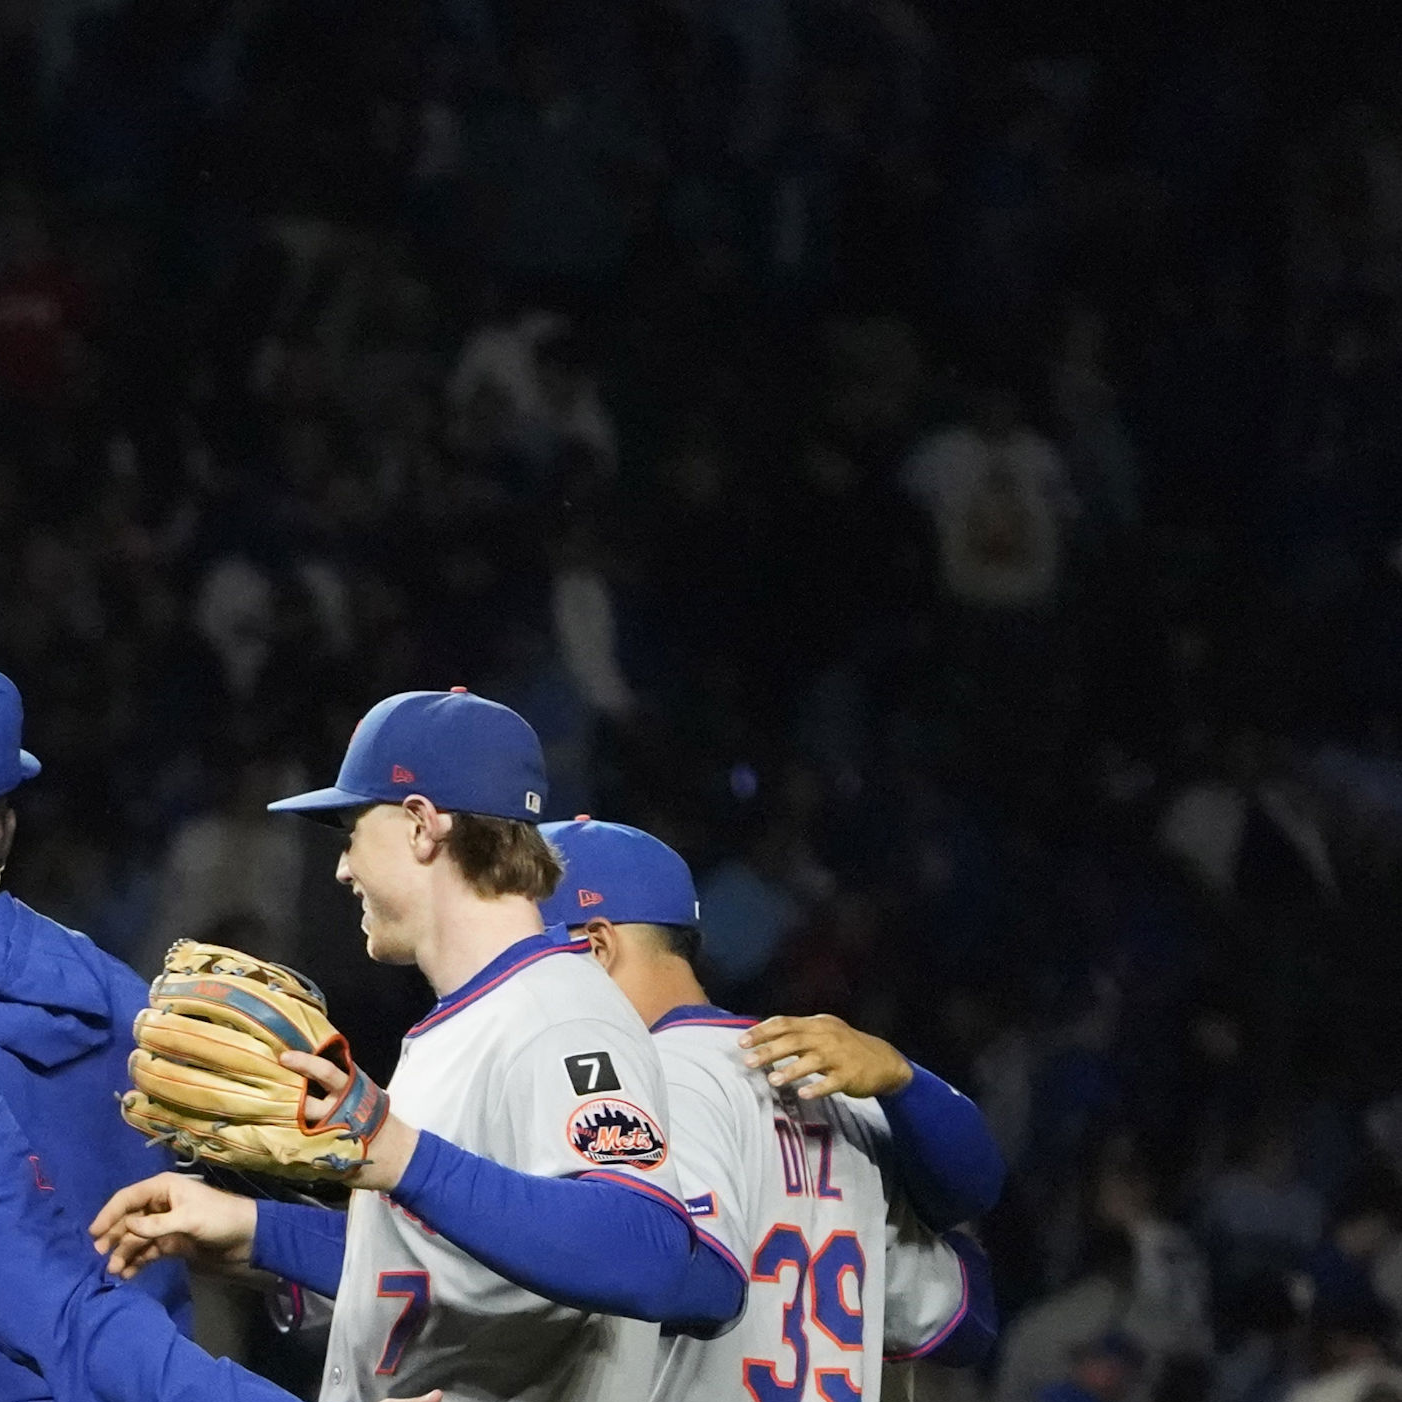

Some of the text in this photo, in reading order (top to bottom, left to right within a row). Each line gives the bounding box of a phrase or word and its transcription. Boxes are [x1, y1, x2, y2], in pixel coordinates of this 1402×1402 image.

[577, 1057, 601, 1090] 7
[588, 1125, 654, 1152] Mets
[374, 1269, 431, 1376] 7
